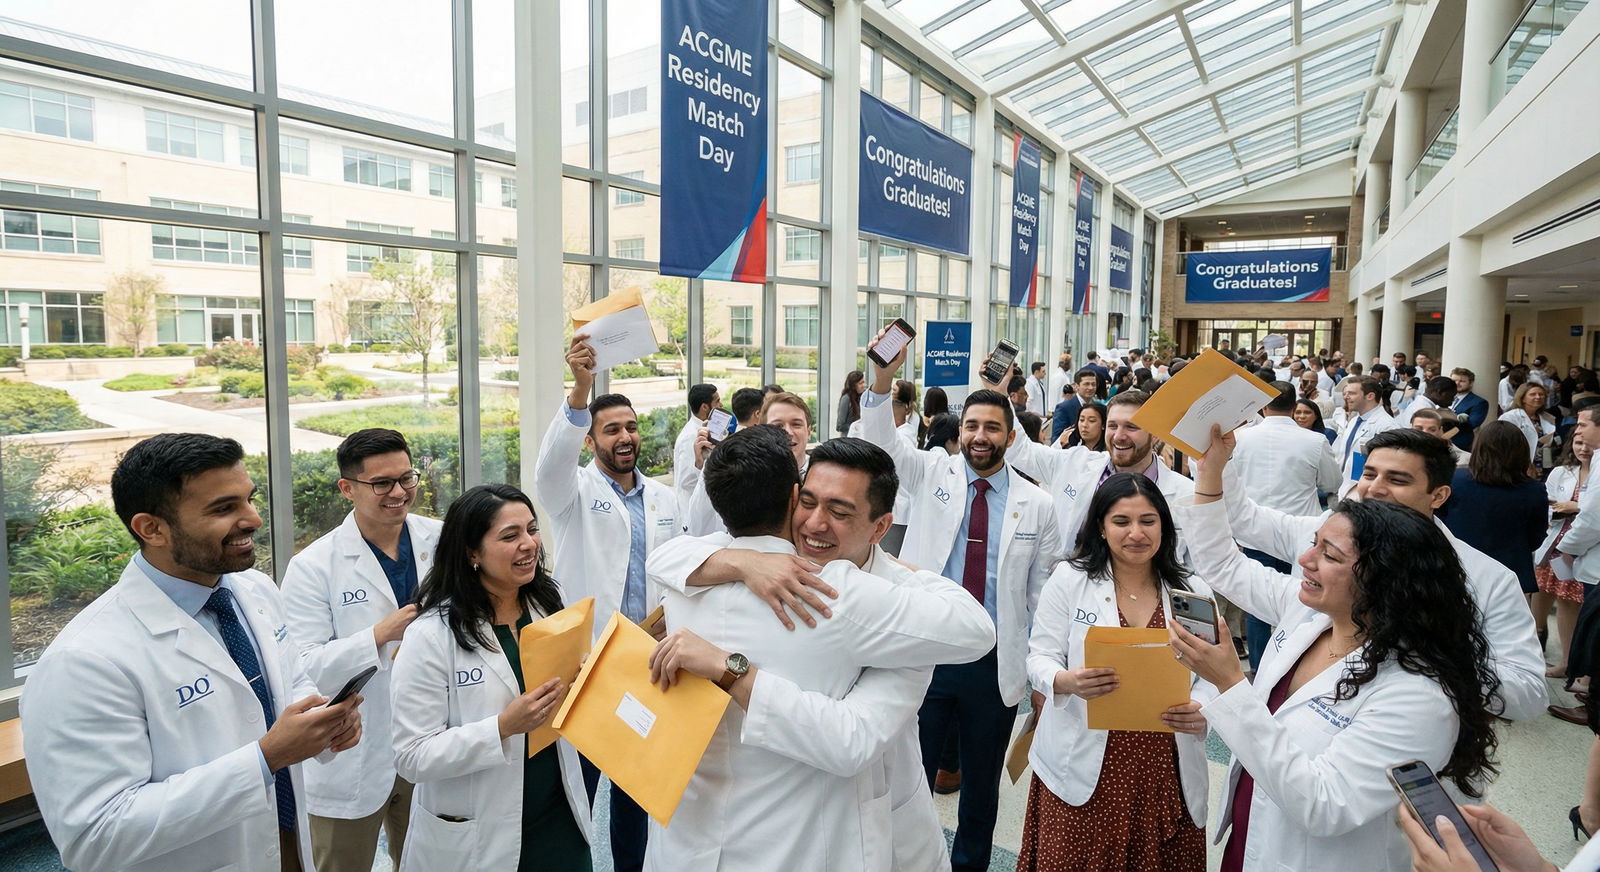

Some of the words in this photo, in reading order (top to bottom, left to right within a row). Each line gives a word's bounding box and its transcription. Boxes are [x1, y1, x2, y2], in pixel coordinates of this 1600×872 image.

[679, 24, 752, 77] ACGME
[668, 53, 761, 116] Residency
[688, 97, 744, 137] Match
[699, 135, 734, 172] Day
[865, 135, 965, 195] Congratulations
[883, 176, 951, 218] Graduates!
[1196, 260, 1319, 277] Congratulations
[1213, 276, 1297, 289] Graduates!
[950, 359, 961, 367] Day
[935, 487, 950, 502] DO
[1065, 484, 1077, 497] DO
[593, 499, 612, 511] DO
[342, 588, 367, 603] DO
[1075, 608, 1098, 624] DO
[456, 667, 483, 684] DO
[175, 677, 210, 705] DO
